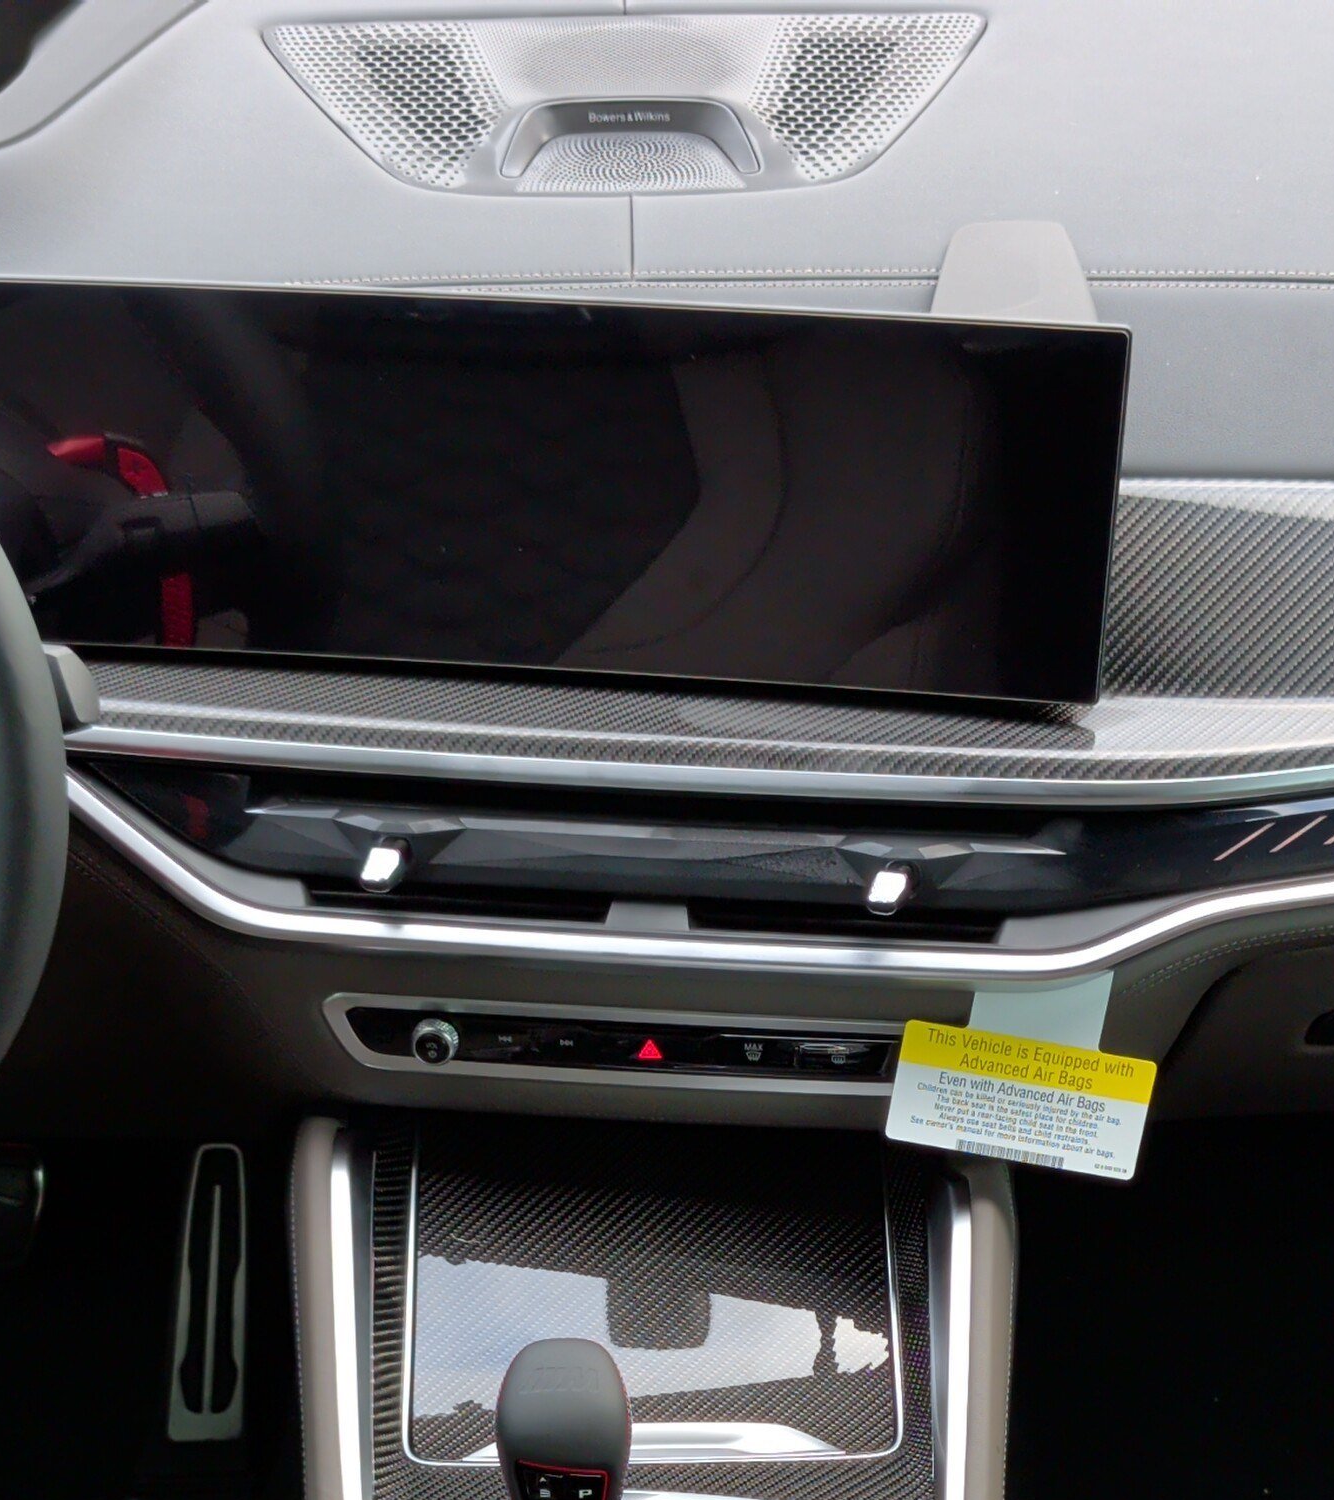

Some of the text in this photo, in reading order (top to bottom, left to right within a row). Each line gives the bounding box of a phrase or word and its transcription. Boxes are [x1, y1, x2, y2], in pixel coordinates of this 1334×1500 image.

[743, 1042, 763, 1050] MAX
[928, 1028, 1135, 1078] This Vehicle is Equipped with
[959, 1053, 1093, 1092] Advanced Air Bags
[917, 1082, 947, 1094] Children
[976, 1093, 995, 1103] killed
[997, 1096, 1005, 1104] or
[1081, 1112, 1093, 1120] the
[1095, 1114, 1105, 1122] air
[939, 1071, 1105, 1113] Even with Advanced Air Bags
[934, 1102, 955, 1113] Never
[997, 1105, 1008, 1114] the
[578, 1488, 593, 1499] P
